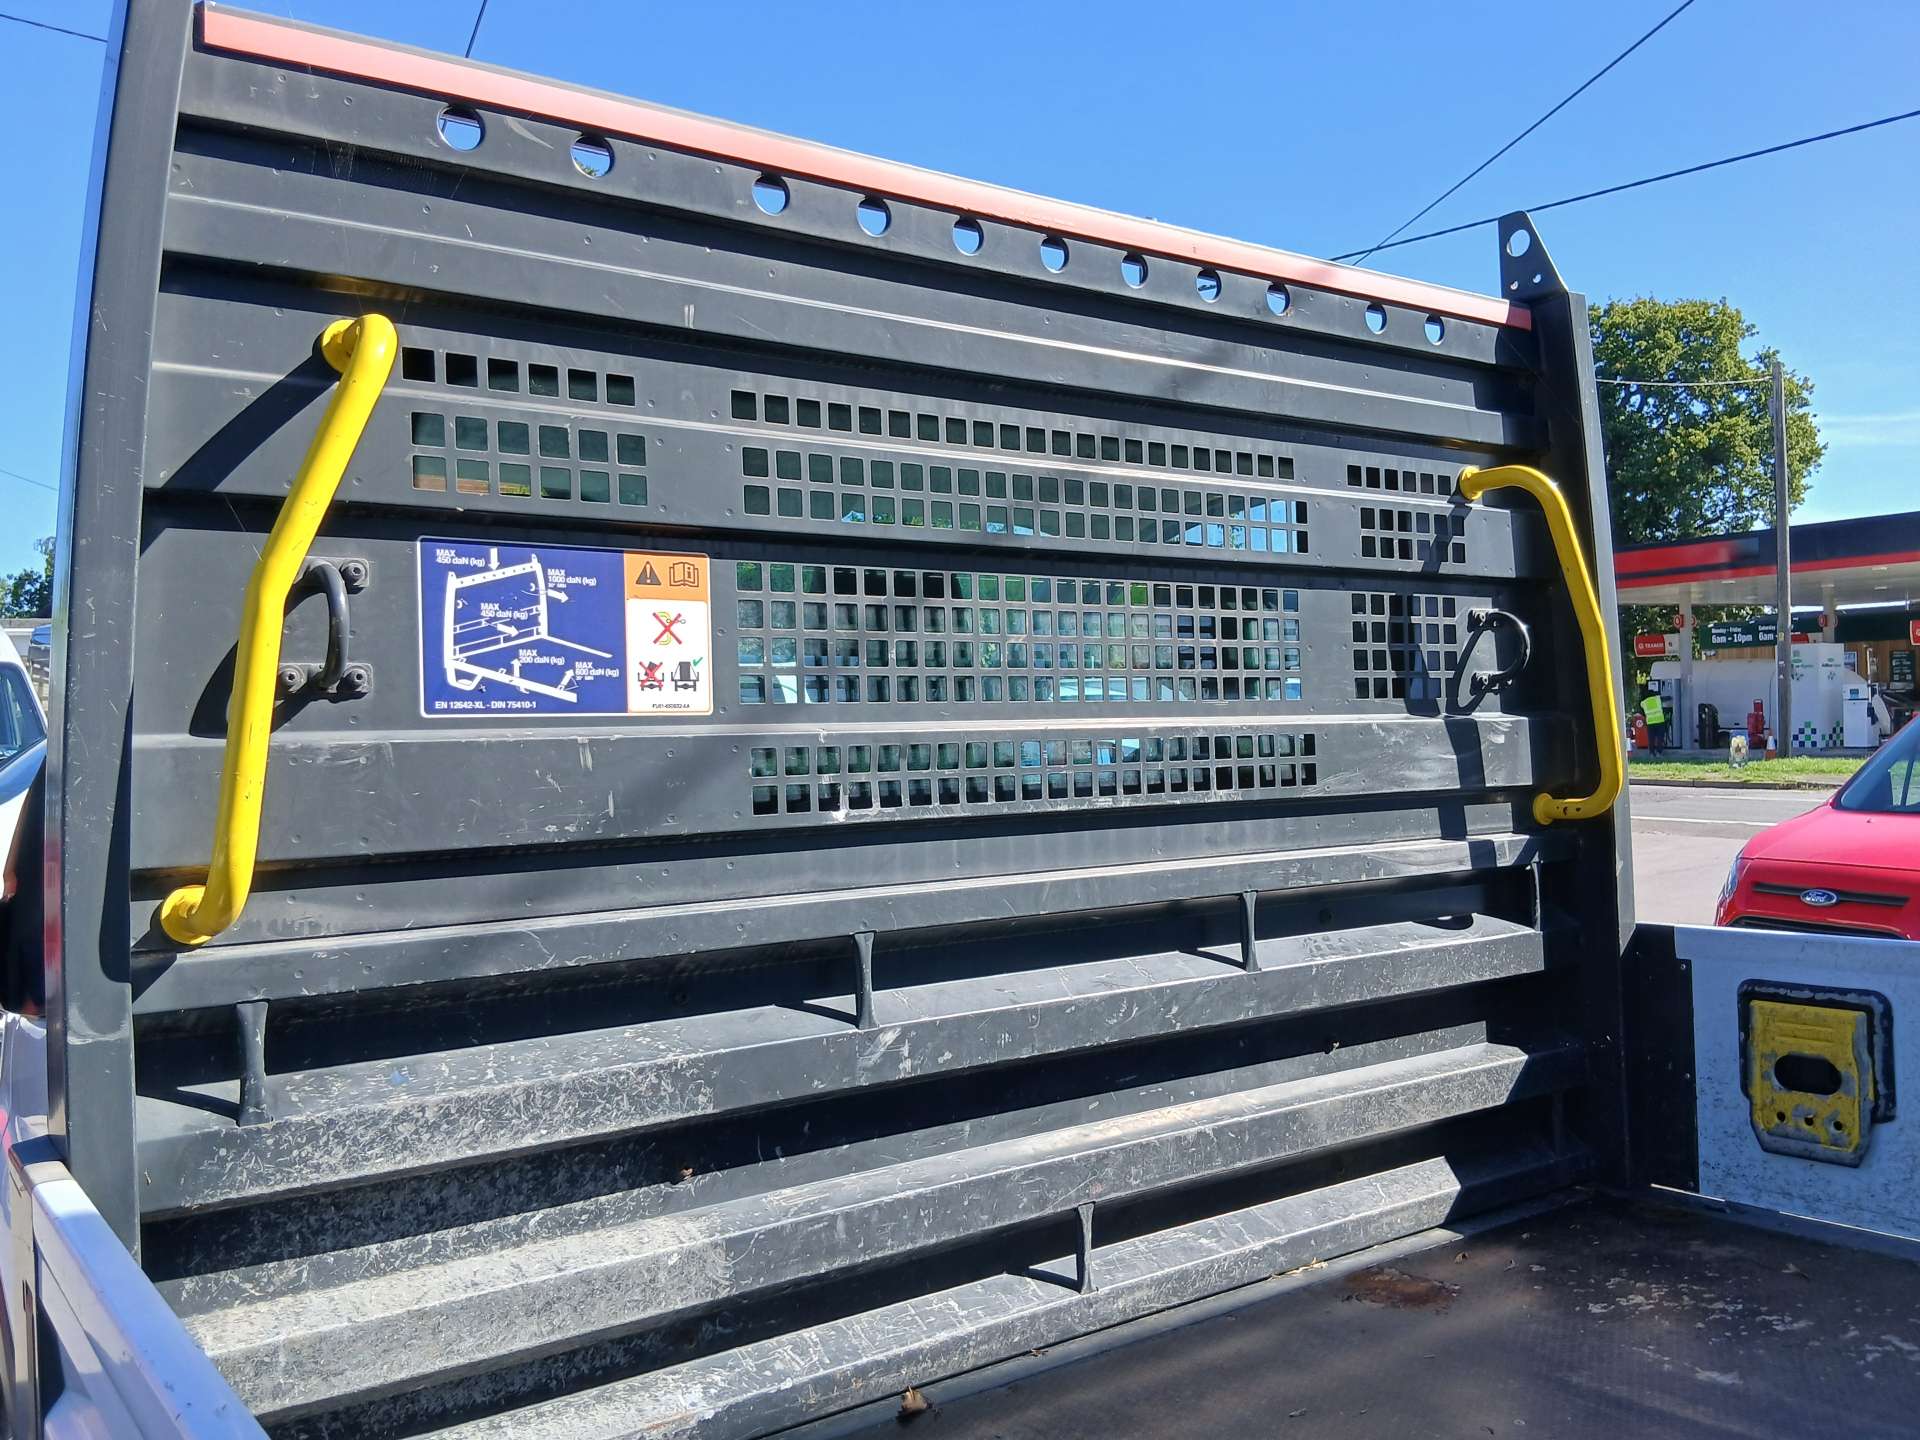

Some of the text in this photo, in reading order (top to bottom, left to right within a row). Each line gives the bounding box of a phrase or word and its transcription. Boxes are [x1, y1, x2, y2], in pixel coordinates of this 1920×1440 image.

[436, 549, 456, 557] MAX
[547, 568, 565, 576] MAX
[566, 576, 582, 584] daN
[582, 577, 597, 586] (kg)
[480, 603, 499, 611] MAX
[480, 610, 528, 620] 450 daN (kg)
[1711, 635, 1726, 644] 6am
[1733, 633, 1753, 644] 10pm
[1758, 632, 1774, 641] 6am
[519, 649, 537, 657] MAX
[519, 656, 533, 664] 200
[550, 657, 565, 665] (kg)
[575, 661, 593, 669] MAX
[605, 668, 619, 677] (kg)
[435, 701, 448, 709] EN
[491, 701, 505, 709] DIN
[507, 701, 537, 709] 75410-1
